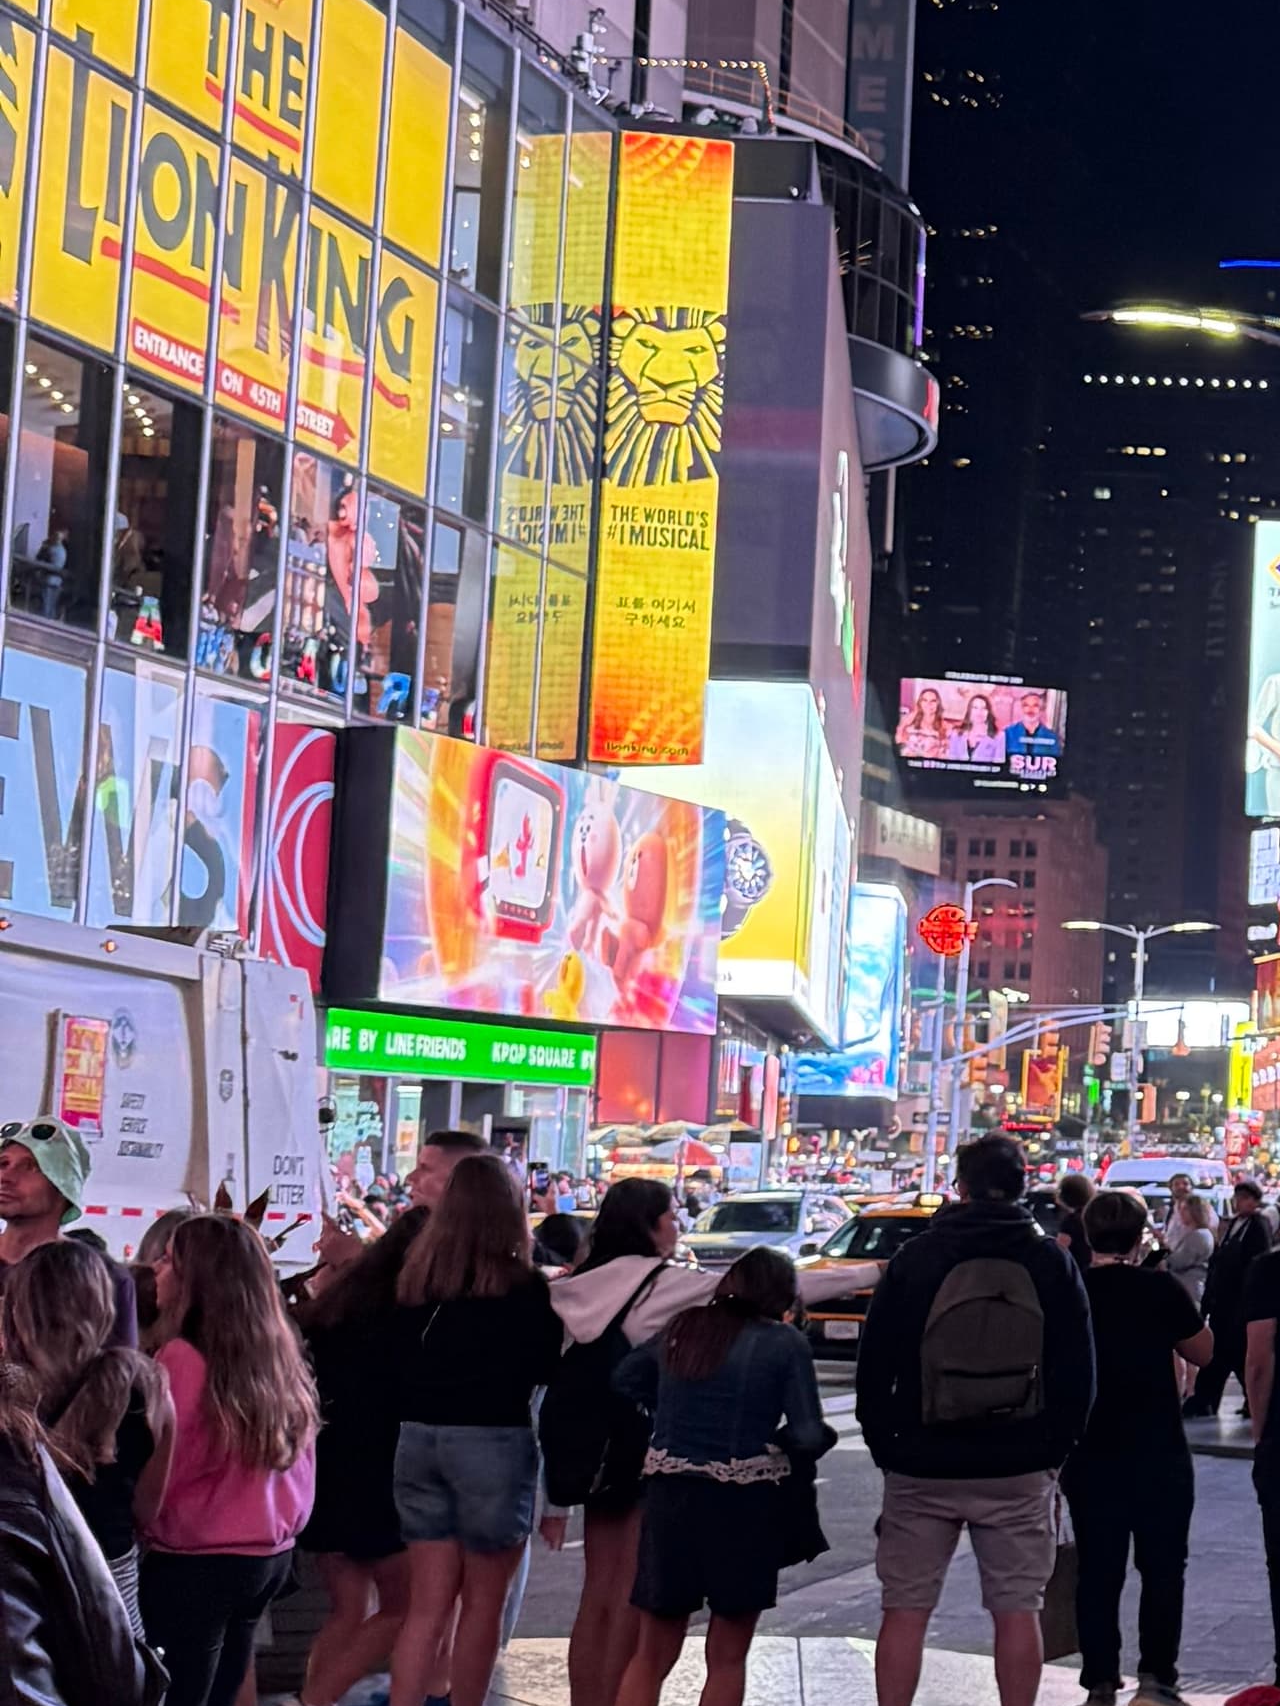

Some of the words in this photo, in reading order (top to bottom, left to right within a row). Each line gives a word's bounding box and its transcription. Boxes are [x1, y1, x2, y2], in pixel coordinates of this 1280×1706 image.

[62, 24, 249, 292] LION
[255, 150, 415, 383] KING
[133, 325, 204, 377] ENTRANCE
[220, 370, 244, 393] ON
[248, 382, 282, 414] 45TH
[296, 406, 336, 439] STREET
[611, 504, 638, 522] THE
[643, 507, 709, 528] WORLD'S
[629, 525, 710, 551] MUSICAL
[327, 1025, 352, 1051] RE
[358, 1028, 379, 1053] BY
[385, 1031, 415, 1057] LINE
[416, 1034, 467, 1061] FRIENDS
[491, 1041, 526, 1065] KPOP
[528, 1045, 576, 1070] SQUARE
